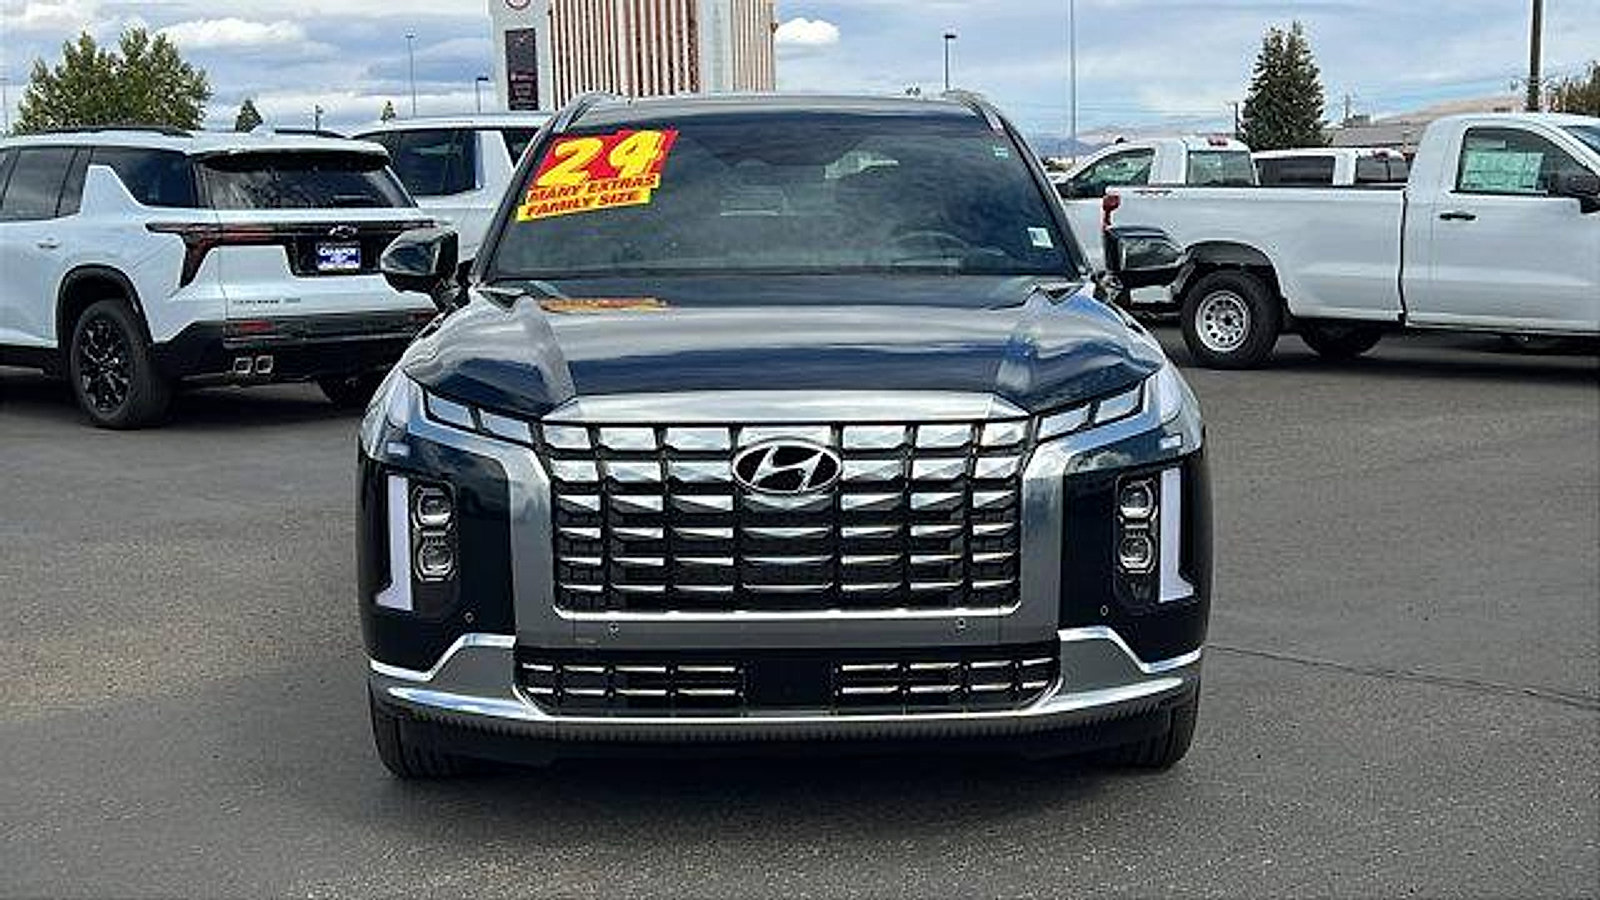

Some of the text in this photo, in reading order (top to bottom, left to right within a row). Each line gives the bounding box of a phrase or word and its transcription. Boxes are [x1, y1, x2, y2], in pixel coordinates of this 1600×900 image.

[537, 130, 665, 187] 24
[527, 176, 656, 203] MANY EXTRAS
[525, 191, 640, 217] FAMILY SIZE
